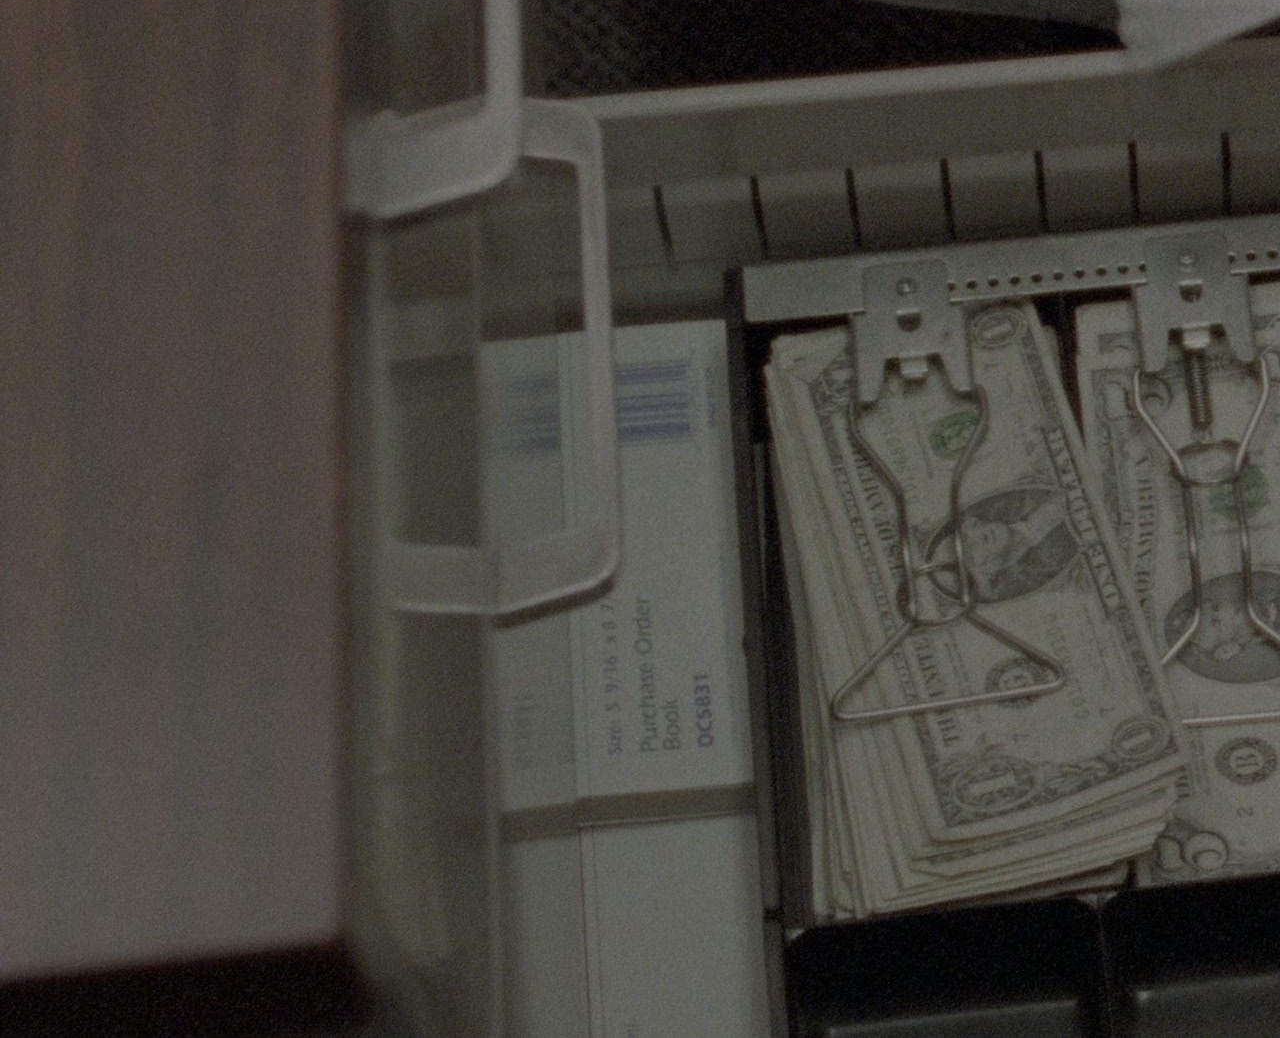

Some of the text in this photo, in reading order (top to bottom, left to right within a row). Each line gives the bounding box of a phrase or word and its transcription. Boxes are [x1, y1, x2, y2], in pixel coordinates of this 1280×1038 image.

[1044, 427, 1120, 609] ONE DOLLAR
[1133, 454, 1157, 561] AMERICA
[632, 596, 657, 753] Purchase Order
[660, 698, 681, 751] Book
[1235, 752, 1260, 768] B
[1156, 831, 1228, 873] 5
